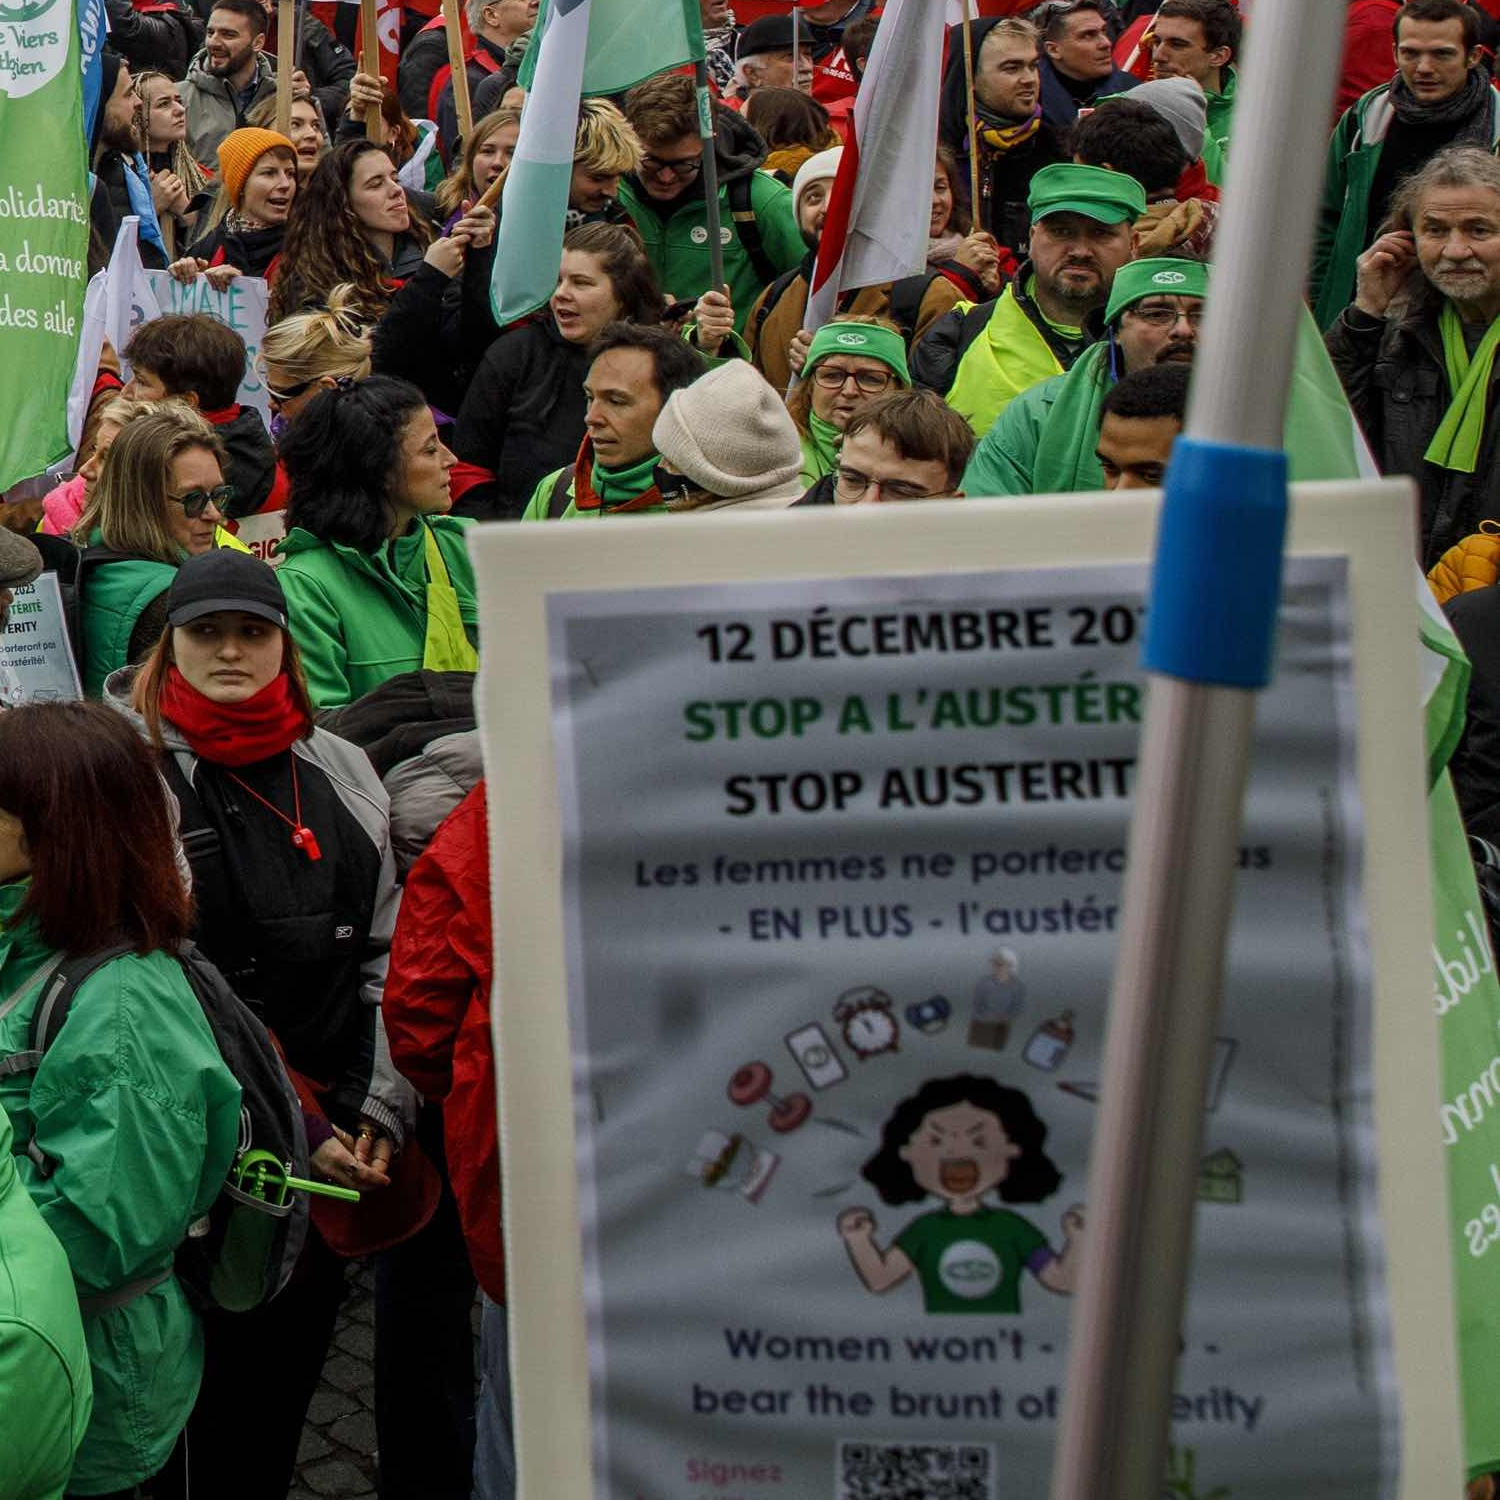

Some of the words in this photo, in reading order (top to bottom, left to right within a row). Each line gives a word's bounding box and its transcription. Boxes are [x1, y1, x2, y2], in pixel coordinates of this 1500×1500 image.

[44, 297, 76, 335] aile
[9, 599, 43, 616] TÉRITÉ
[696, 623, 756, 664] 12
[771, 606, 1054, 662] DÉCEMBRE
[1068, 606, 1146, 647] 20
[683, 697, 824, 743] STOP
[837, 694, 872, 736] A
[886, 671, 1144, 731] L'AUSTÉR
[724, 769, 864, 816] STOP
[878, 758, 1139, 808] AUSTERIT
[634, 859, 699, 889] Les
[712, 853, 887, 885] femmes
[901, 854, 954, 880] ne
[748, 906, 803, 942] EN
[818, 903, 913, 940] PLUS
[959, 901, 1119, 937] l'austér
[723, 1328, 891, 1363] Women
[906, 1328, 1023, 1363] won't
[692, 1384, 791, 1416] bear
[806, 1384, 873, 1416] the
[890, 1385, 1002, 1420] brunt
[1017, 1384, 1059, 1420] of
[1172, 1380, 1264, 1431] erity
[686, 1459, 782, 1486] Signez
